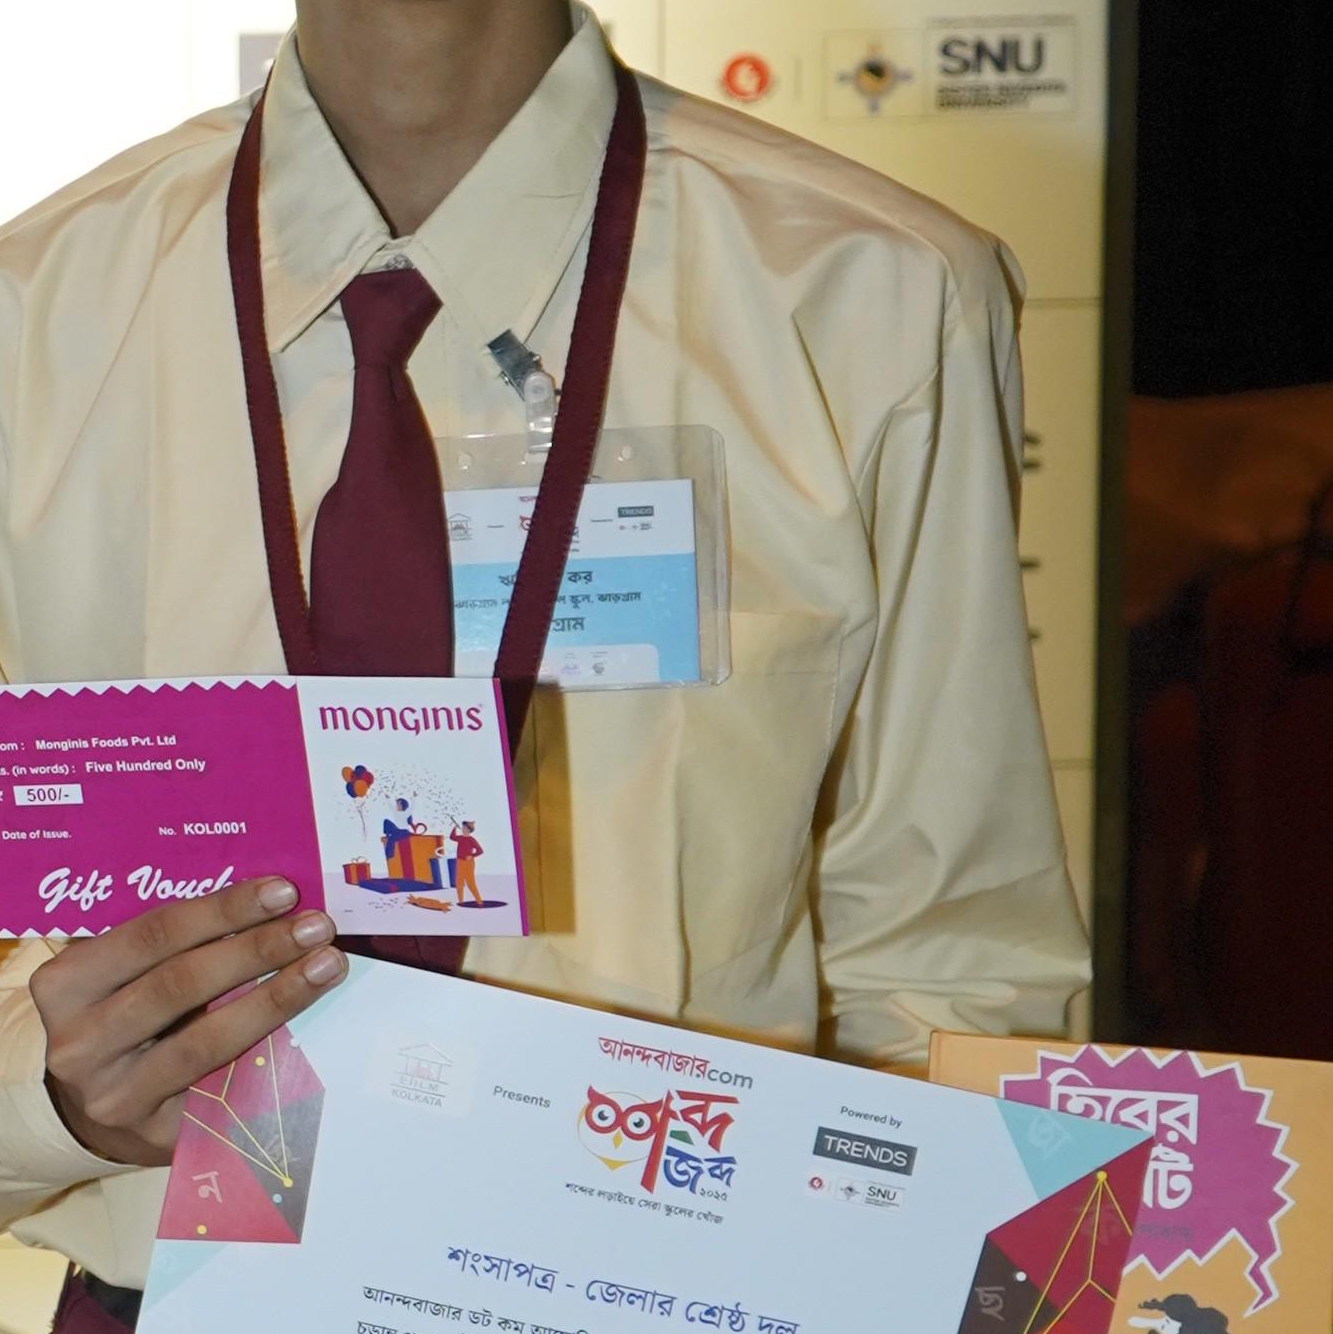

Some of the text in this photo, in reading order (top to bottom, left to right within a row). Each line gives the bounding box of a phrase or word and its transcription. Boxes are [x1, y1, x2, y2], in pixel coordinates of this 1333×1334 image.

[939, 34, 1044, 75] SNU
[36, 735, 176, 751] Monginis Foods Pvt. Ltd
[12, 766, 27, 777] (in
[85, 761, 113, 773] Five
[116, 760, 172, 772] Hundred
[175, 758, 205, 772] Only
[27, 788, 70, 802] 500/-
[2, 830, 28, 840] Date
[29, 830, 40, 839] of
[159, 827, 177, 836] No.
[183, 822, 247, 835] KOL0001
[38, 867, 114, 914] Gift
[391, 1088, 445, 1110] KOLKATA
[492, 1084, 552, 1110] Presents
[840, 1105, 903, 1129] Powered by
[823, 1134, 909, 1167] TRENDS
[866, 1185, 897, 1202] SNU
[446, 1246, 559, 1293] শংসাপত্র
[585, 1279, 677, 1317] জেলার
[686, 1302, 750, 1333] শ্রেষ্ঠ
[363, 1285, 463, 1322] আনন্দবাজার
[468, 1309, 493, 1328] ডট
[497, 1315, 525, 1334] কম
